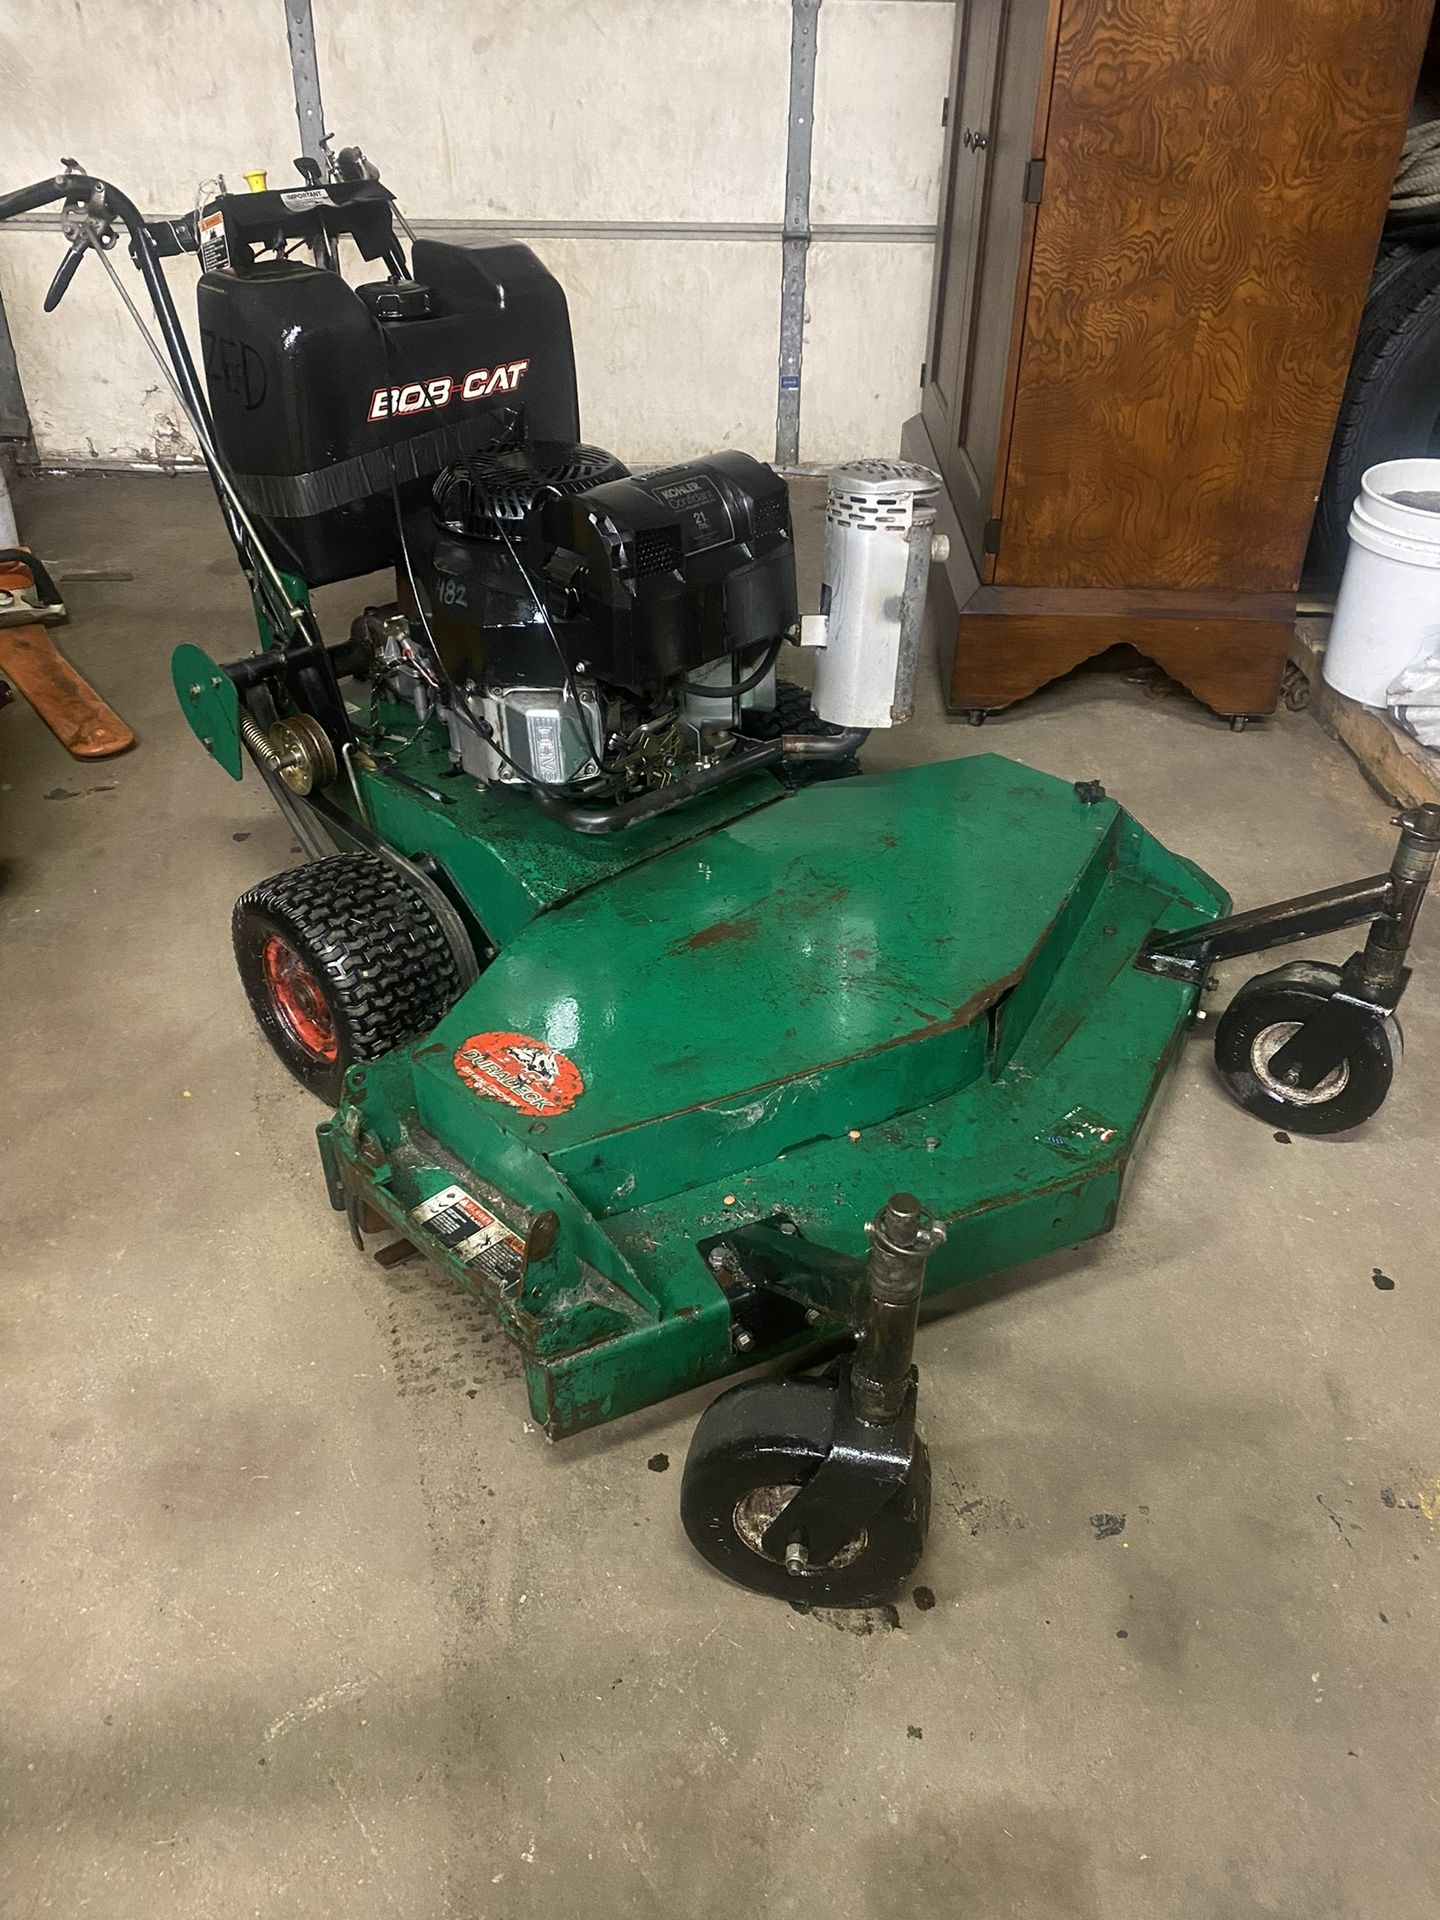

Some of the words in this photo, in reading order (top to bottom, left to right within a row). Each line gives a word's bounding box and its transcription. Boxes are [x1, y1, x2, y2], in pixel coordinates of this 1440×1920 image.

[286, 190, 322, 201] IMPORTANT
[368, 359, 530, 421] BOB-CAT
[660, 482, 702, 499] KOHLER
[693, 511, 706, 525] 21
[460, 1048, 557, 1112] DURADECK
